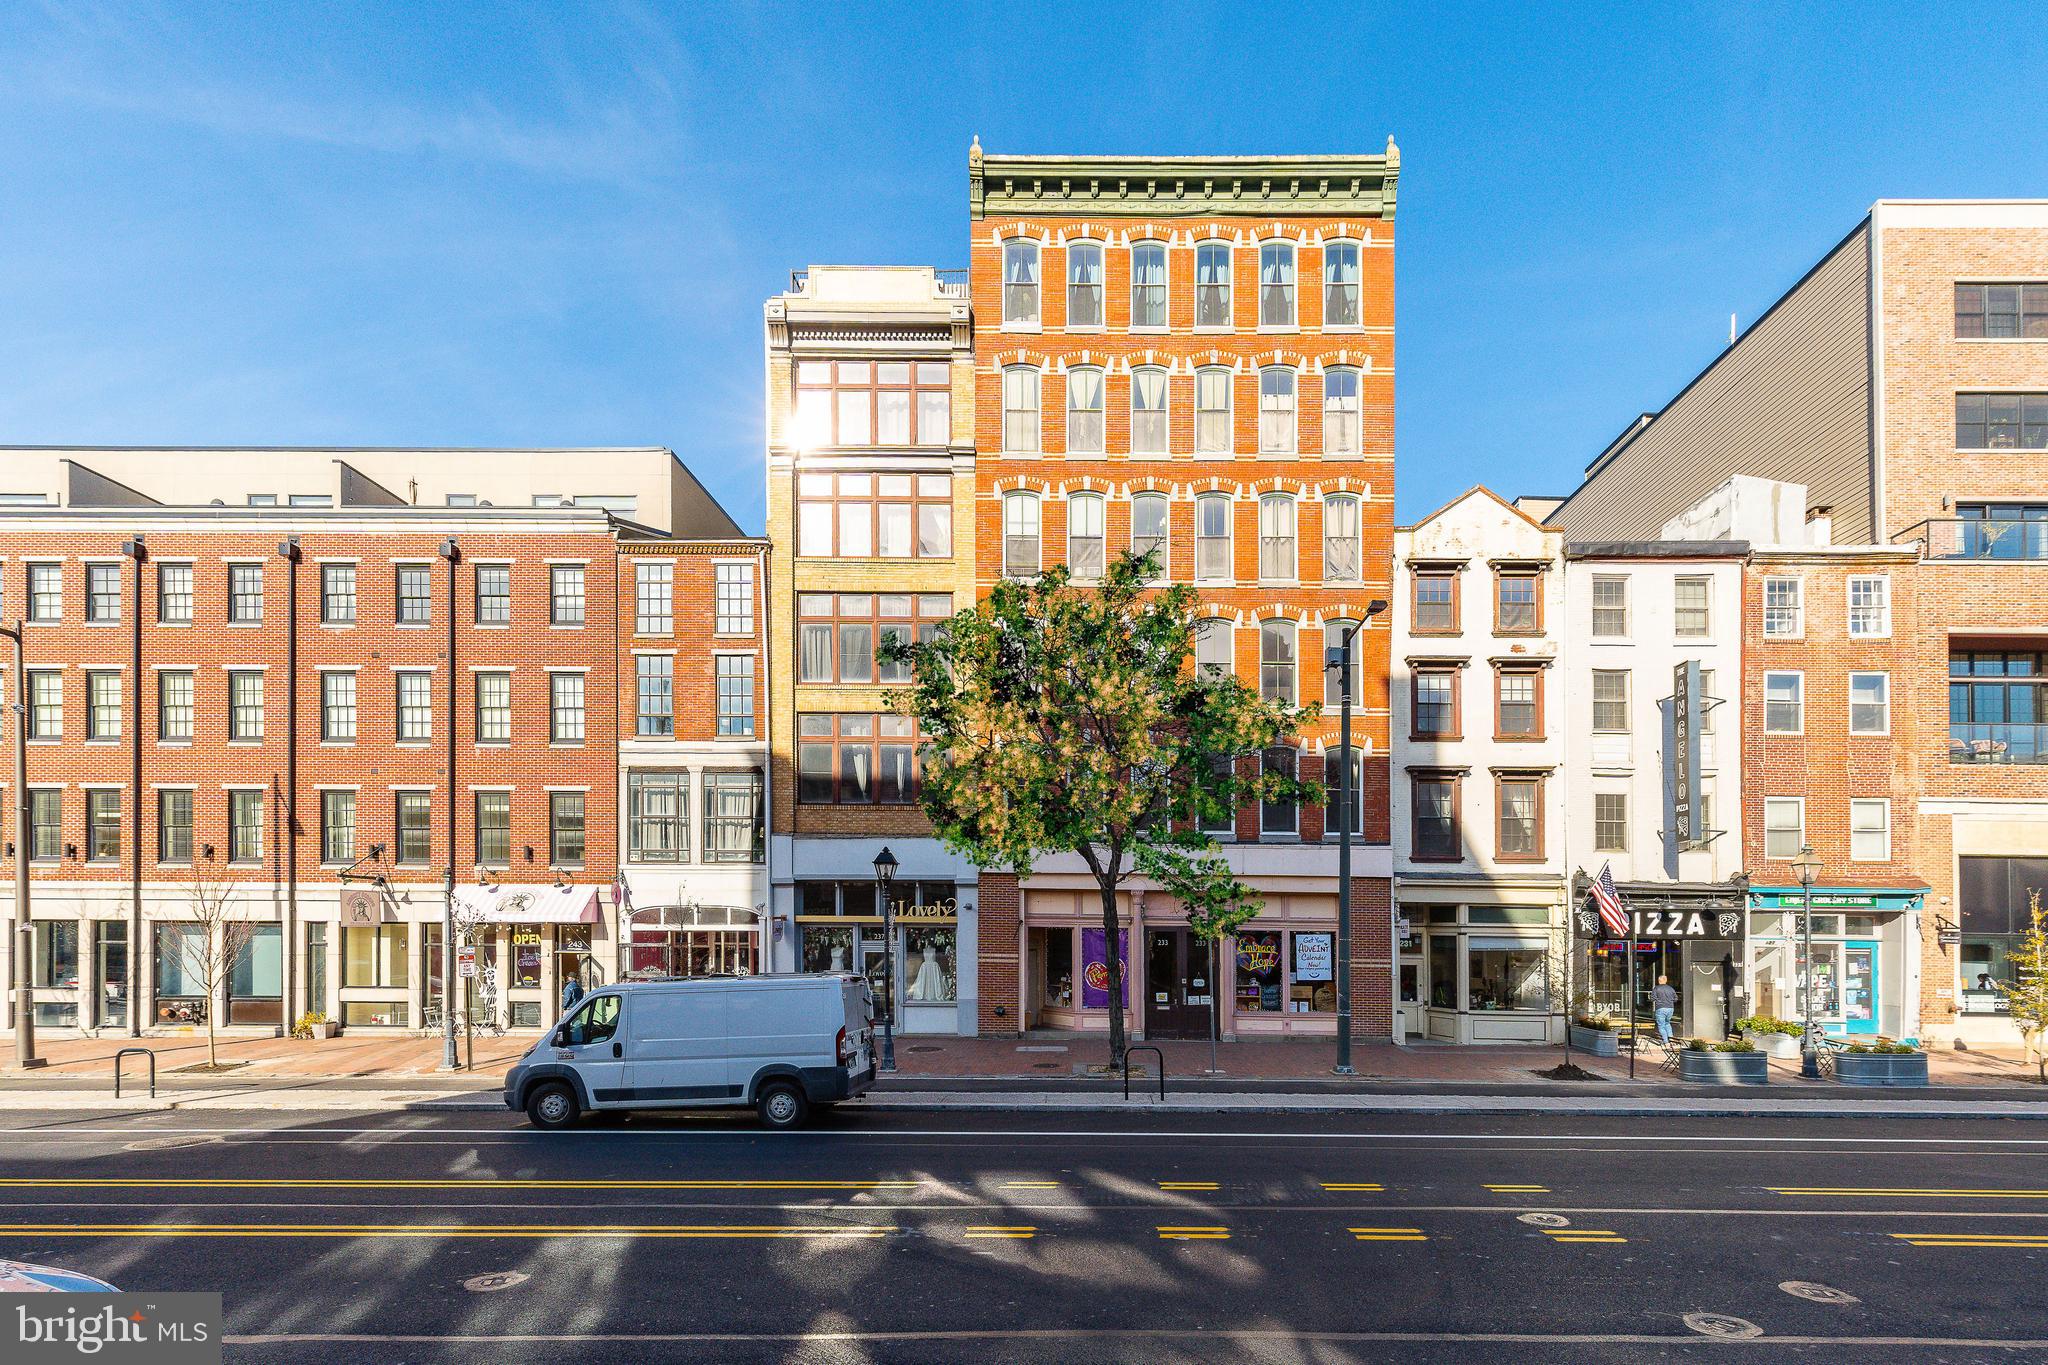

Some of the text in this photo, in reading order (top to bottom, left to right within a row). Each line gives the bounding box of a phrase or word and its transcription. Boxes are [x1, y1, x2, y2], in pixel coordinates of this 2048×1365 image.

[1677, 679, 1687, 800] ANGELO
[1847, 896, 1872, 905] STORE
[897, 898, 958, 924] Lovely
[1613, 912, 1705, 935] IZZA
[513, 933, 541, 945] OPEN
[567, 940, 584, 948] 243
[1237, 938, 1277, 953] Embrace
[1250, 953, 1275, 970] Hope
[1301, 953, 1327, 961] Calendar
[1800, 995, 1826, 1003] SOKE
[1596, 1003, 1620, 1012] BYOB
